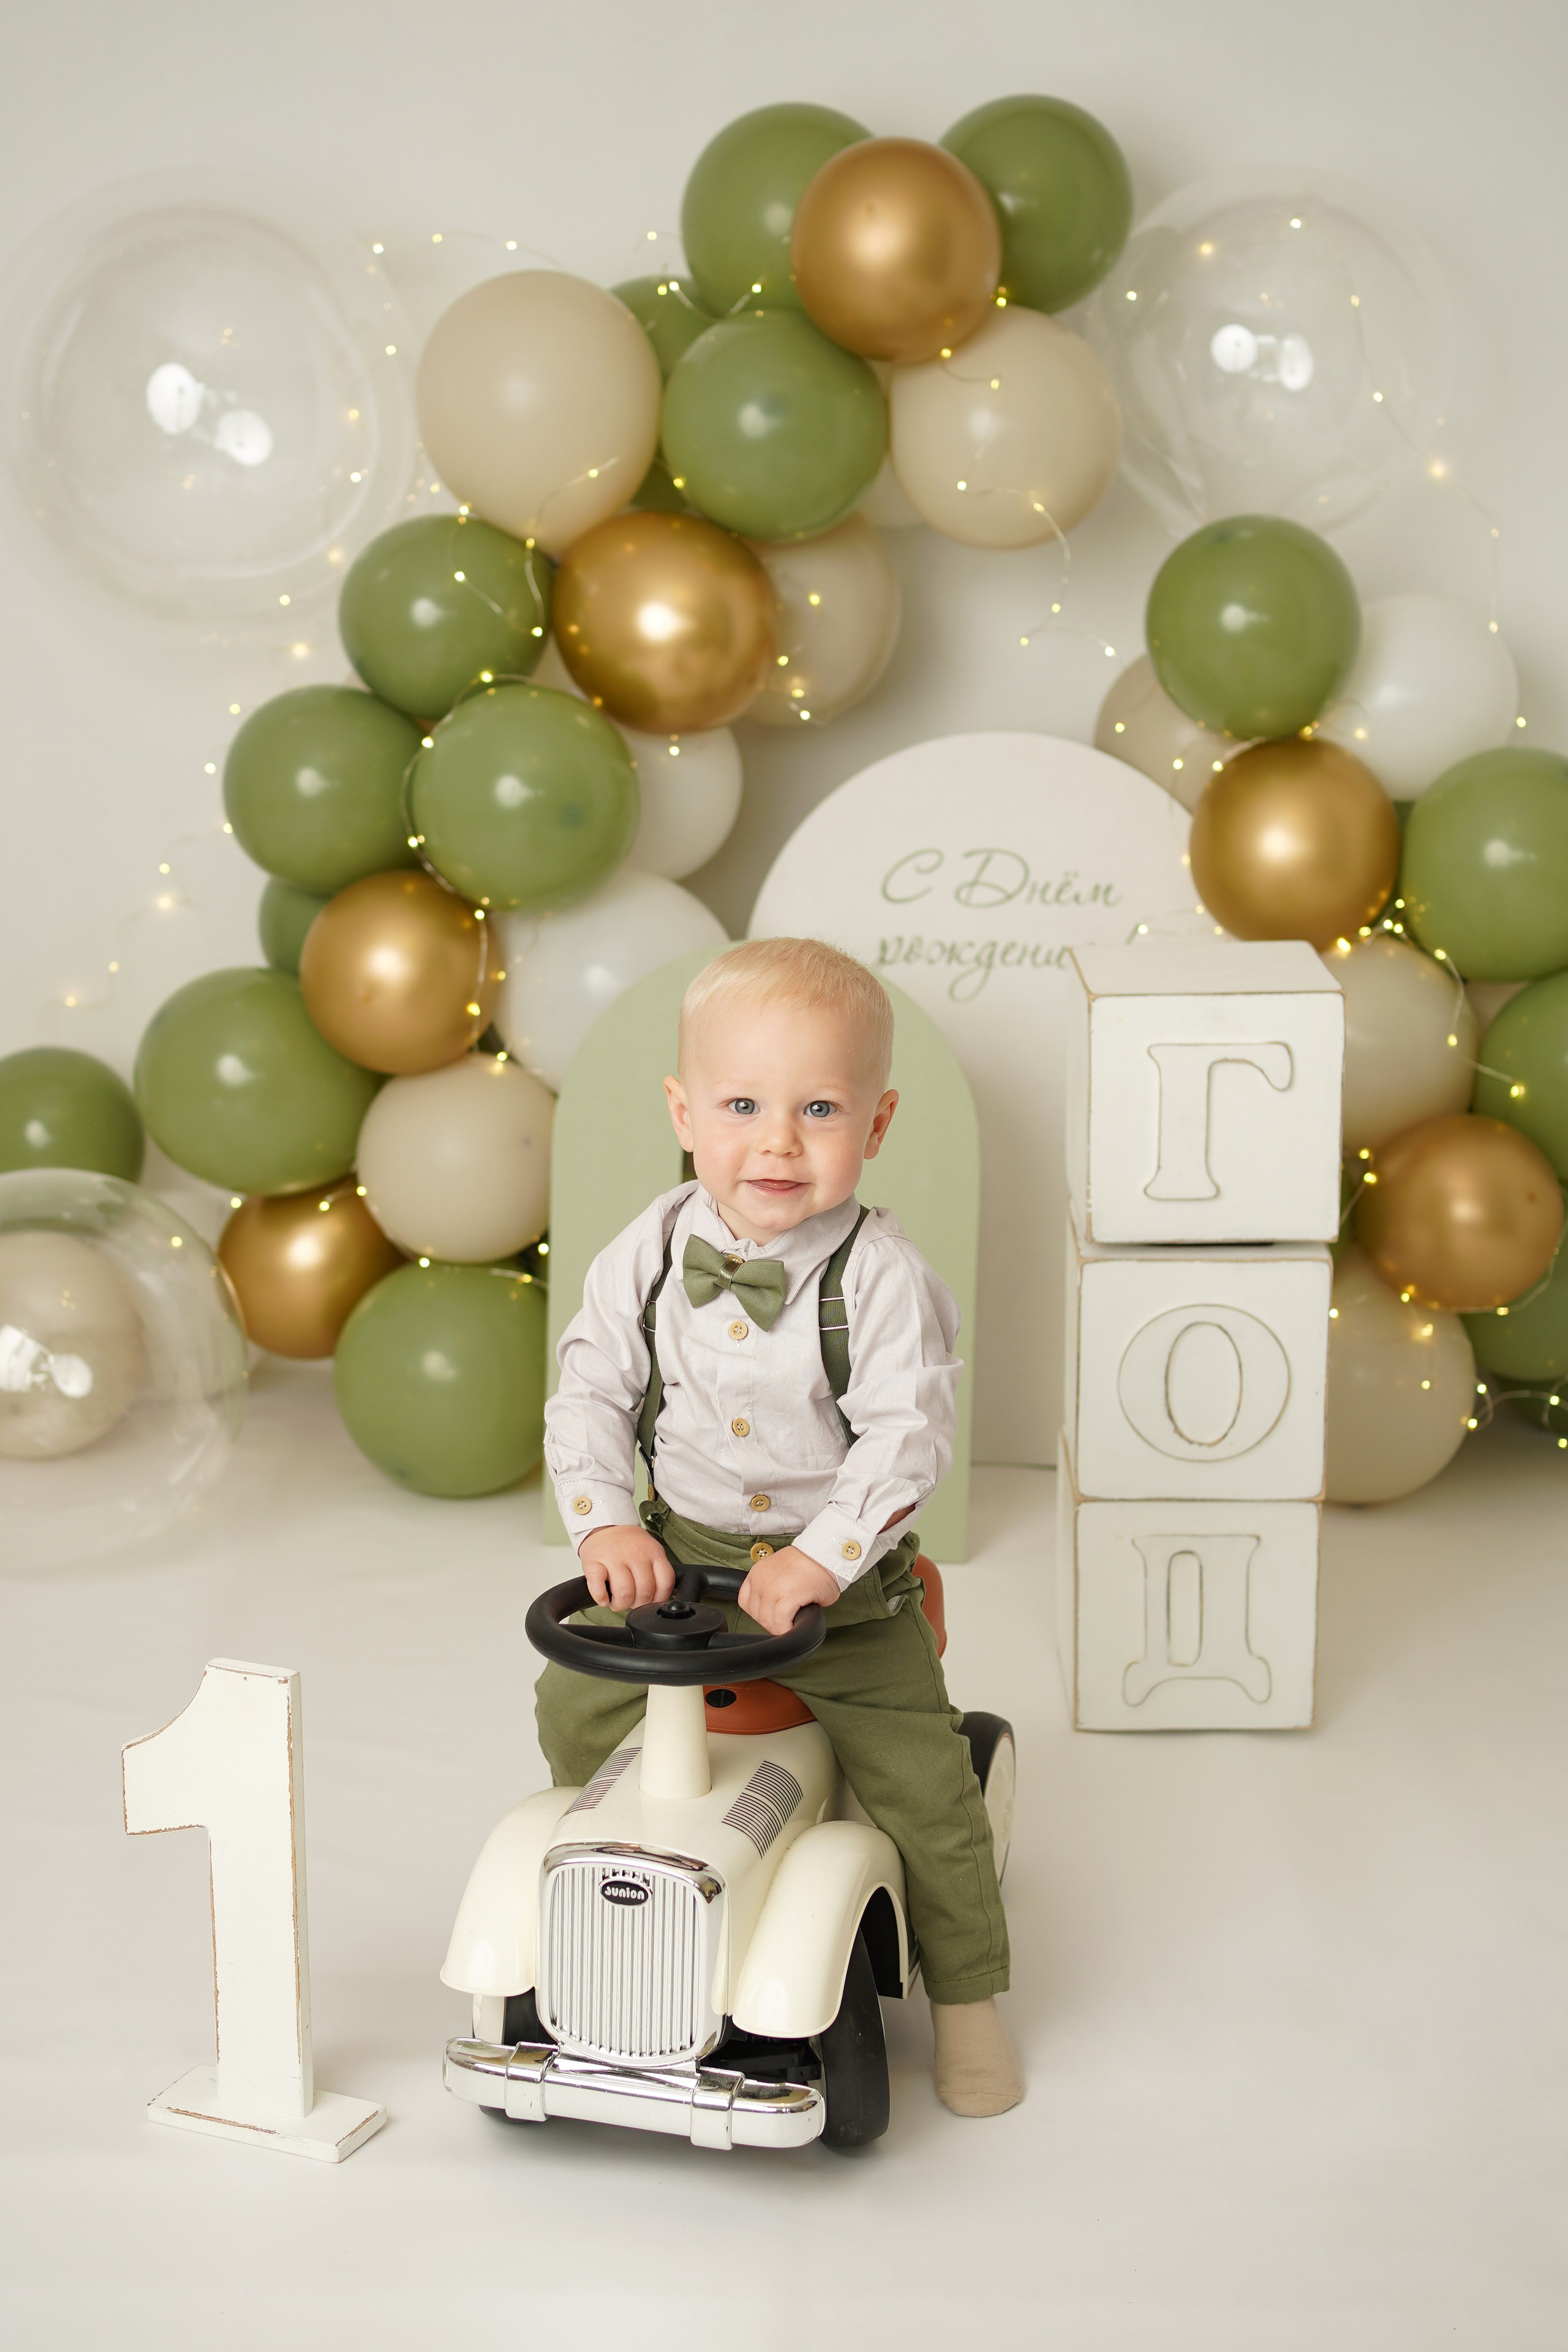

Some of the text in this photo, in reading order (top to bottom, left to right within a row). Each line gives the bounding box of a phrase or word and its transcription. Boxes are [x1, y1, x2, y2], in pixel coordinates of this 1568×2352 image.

[880, 847, 1125, 909] С Днём
[874, 924, 1139, 1003] рождени
[121, 1657, 314, 2118] 1
